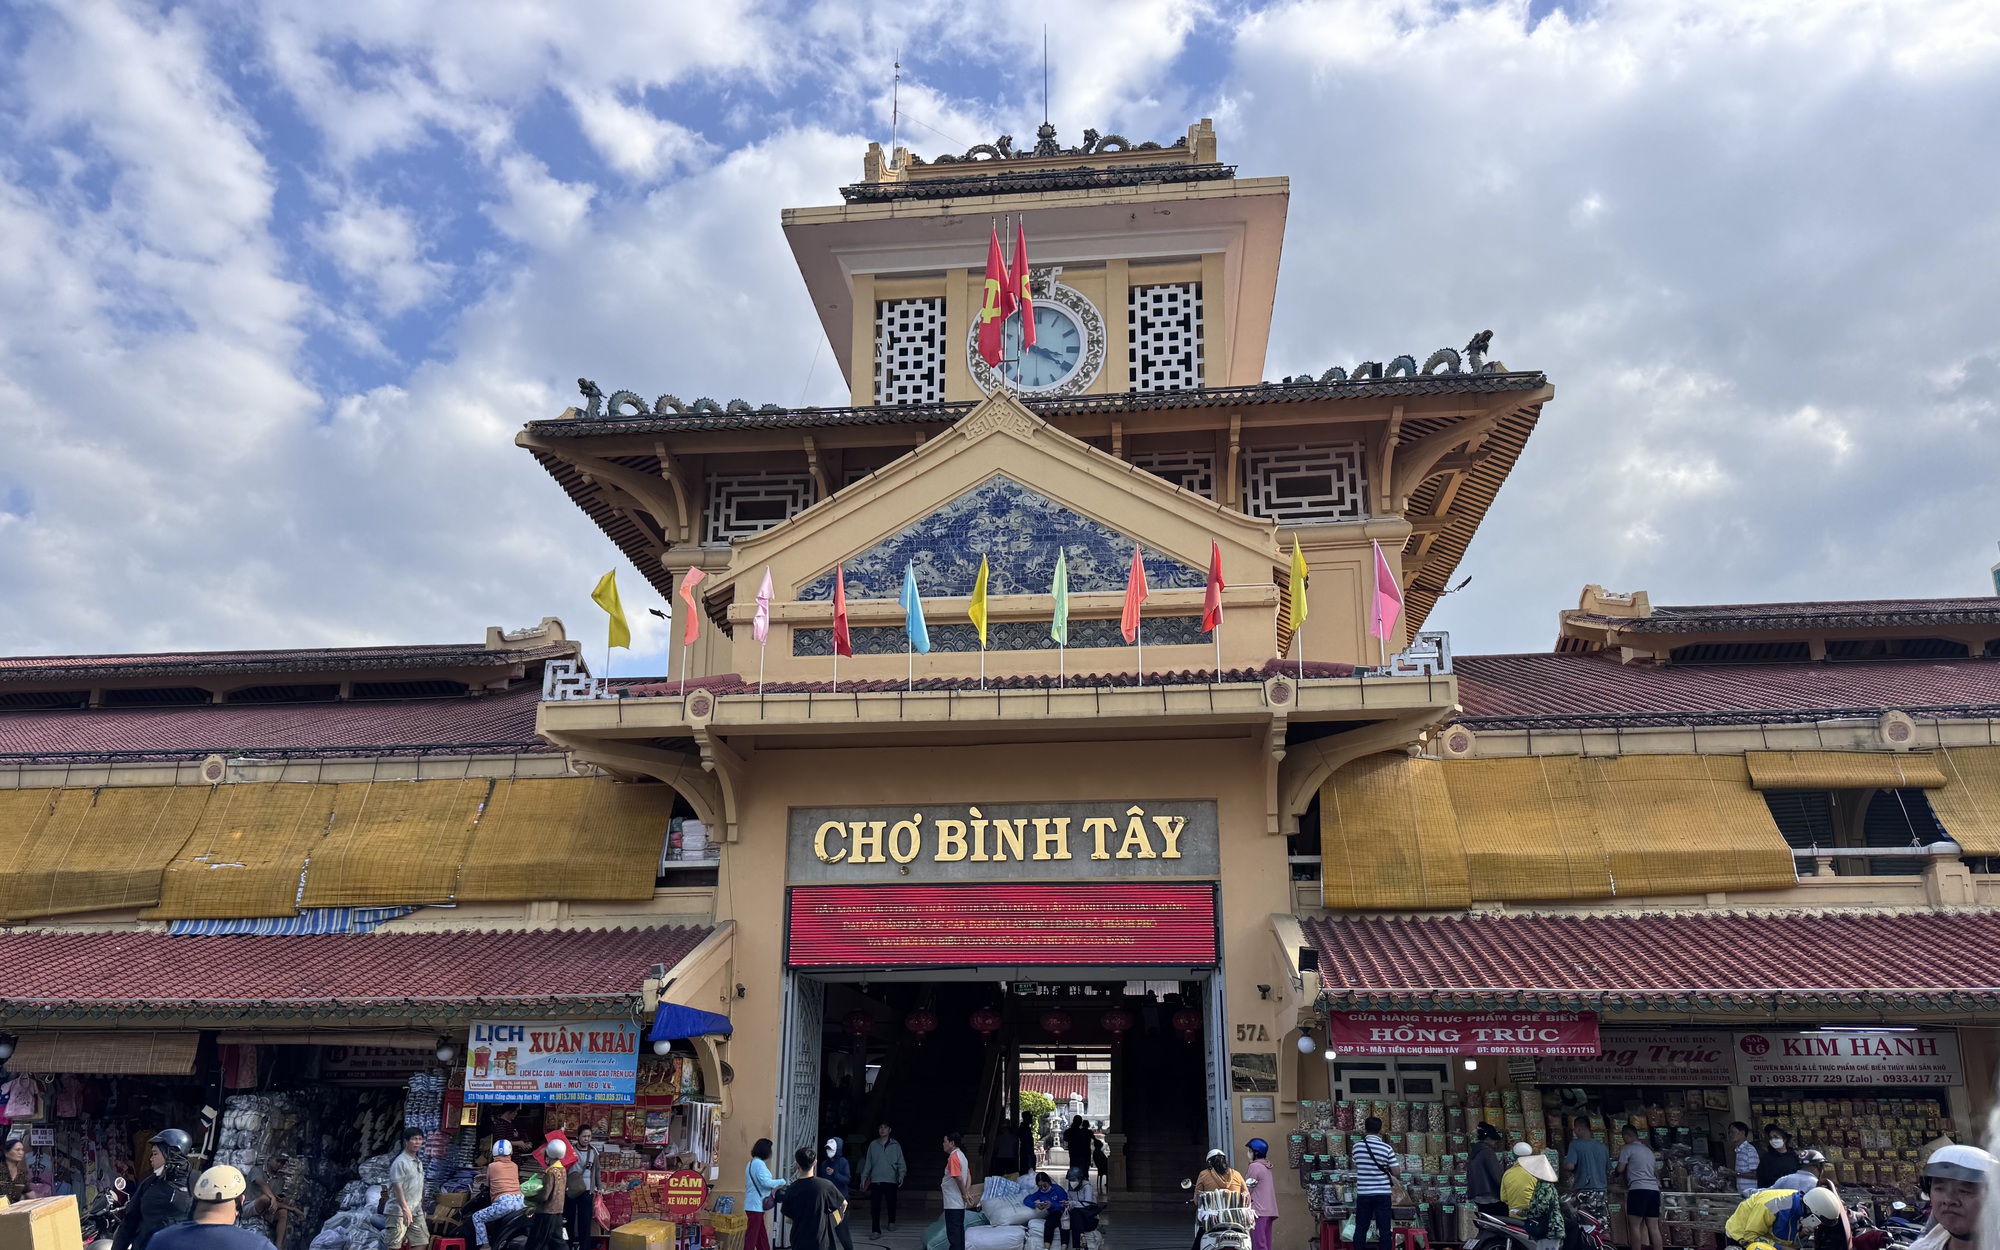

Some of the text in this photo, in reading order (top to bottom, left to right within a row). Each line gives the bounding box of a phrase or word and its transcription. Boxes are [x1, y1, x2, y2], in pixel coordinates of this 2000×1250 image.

[814, 804, 1190, 875] CHỢ BÌNH TÂY
[1348, 1012, 1579, 1024] CỬA HÀNG THỰC PHẨM CHẾ BIẾN
[475, 1025, 524, 1045] LỊCH
[1237, 1023, 1270, 1041] 57A
[1369, 1023, 1560, 1042] HỒNG TRÚC
[529, 1024, 636, 1054] XUÂN KHẢI
[1609, 1036, 1635, 1044] THỰC
[1638, 1035, 1667, 1043] PHẨM
[1338, 1046, 1354, 1054] SẠP
[1388, 1045, 1405, 1053] TIỀN
[1407, 1046, 1423, 1054] CHỢ
[1424, 1045, 1443, 1053] BÌNH
[1445, 1045, 1459, 1053] TÂY
[1648, 1045, 1722, 1062] Trúc
[1746, 1044, 1766, 1053] 16
[1780, 1037, 1939, 1061] KIM HẠNH
[1753, 1063, 1778, 1071] CHUYÊN
[1780, 1063, 1793, 1071] BÁN
[1818, 1063, 1835, 1071] THỰC
[1837, 1062, 1855, 1070] PHẨM
[1856, 1062, 1870, 1070] CHẾ
[1871, 1062, 1886, 1070] BIẾN
[544, 1081, 562, 1089] BÁNH
[1750, 1075, 1763, 1083] ĐT
[1772, 1075, 1819, 1083] 0938.777
[1823, 1075, 1842, 1083] 229
[1845, 1075, 1873, 1084] (Zalo)
[1883, 1075, 1930, 1083] 0933.417
[1934, 1074, 1952, 1083] 217
[669, 1175, 702, 1188] CẤM
[667, 1196, 701, 1207] XE VÀO CHỢ
